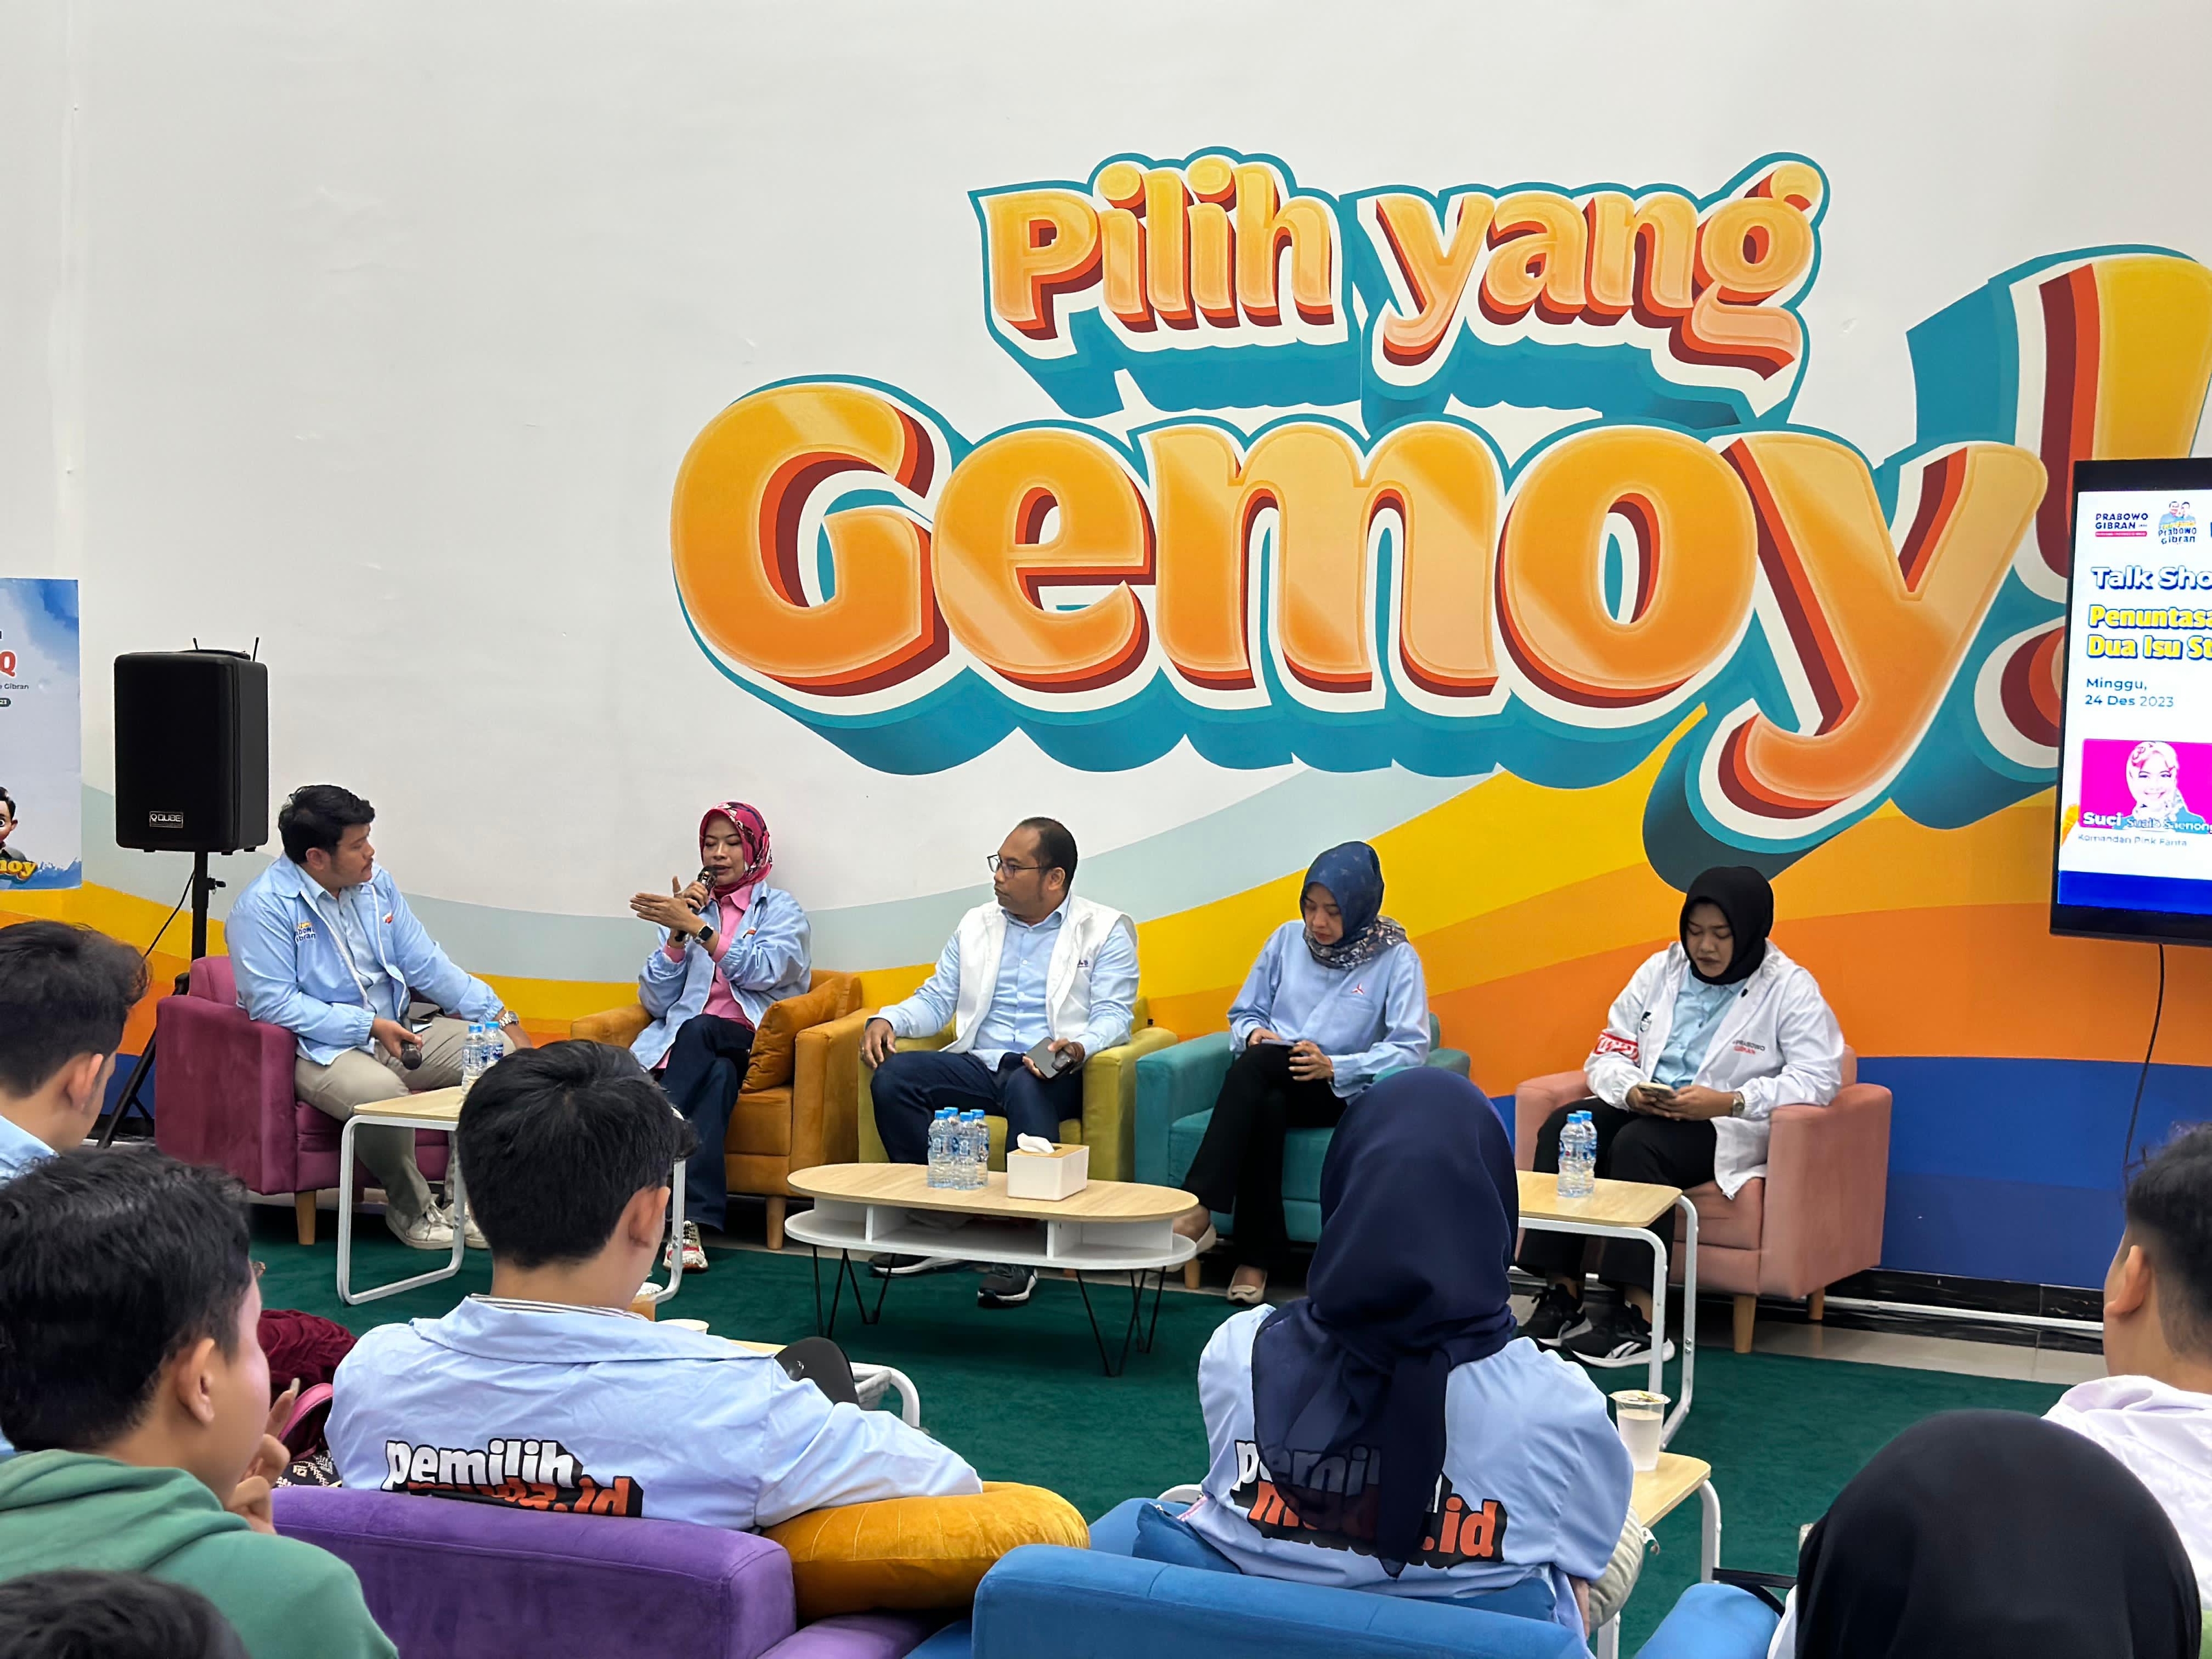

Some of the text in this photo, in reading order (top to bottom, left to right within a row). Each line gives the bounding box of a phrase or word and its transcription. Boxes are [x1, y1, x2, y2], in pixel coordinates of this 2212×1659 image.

[984, 154, 1823, 381] Pilih yang
[2090, 565, 2153, 589] Talk
[2087, 634, 2138, 658] Dua
[2143, 635, 2183, 660] Isu
[2086, 677, 2147, 691] Minggu,
[2085, 695, 2173, 707] 24 Des 2023
[2083, 812, 2122, 826] Suci
[382, 1439, 576, 1491] pemilih
